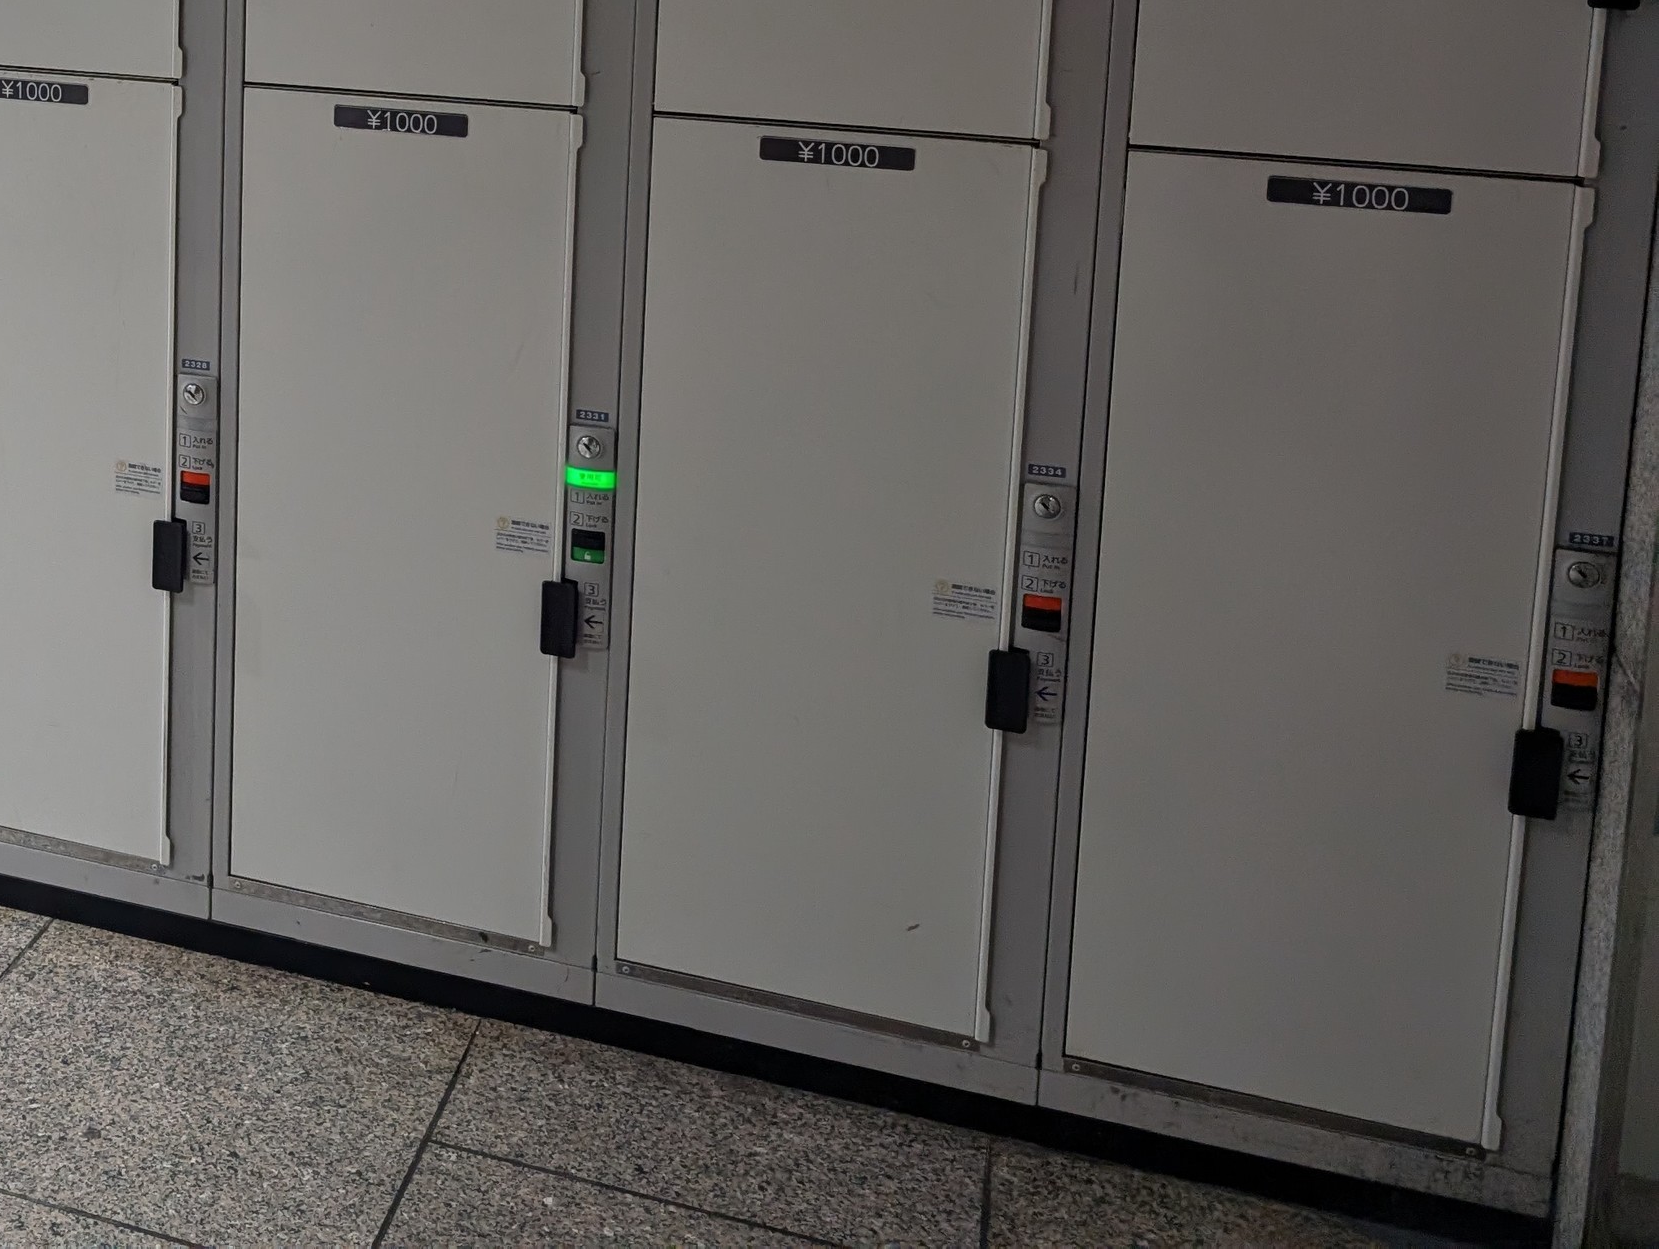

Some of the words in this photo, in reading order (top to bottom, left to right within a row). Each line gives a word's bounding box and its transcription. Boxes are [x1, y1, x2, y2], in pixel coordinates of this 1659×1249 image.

[2, 80, 61, 102] ¥1000
[367, 110, 437, 134] ¥1000
[798, 142, 878, 167] ¥1000
[1313, 182, 1408, 210] ¥1000
[579, 411, 605, 421] 2331
[192, 437, 214, 445] 入れる
[1032, 465, 1063, 476] 2334
[1042, 556, 1068, 565] 入れる
[1042, 580, 1067, 589] 下げる
[1037, 668, 1062, 677] 支払う
